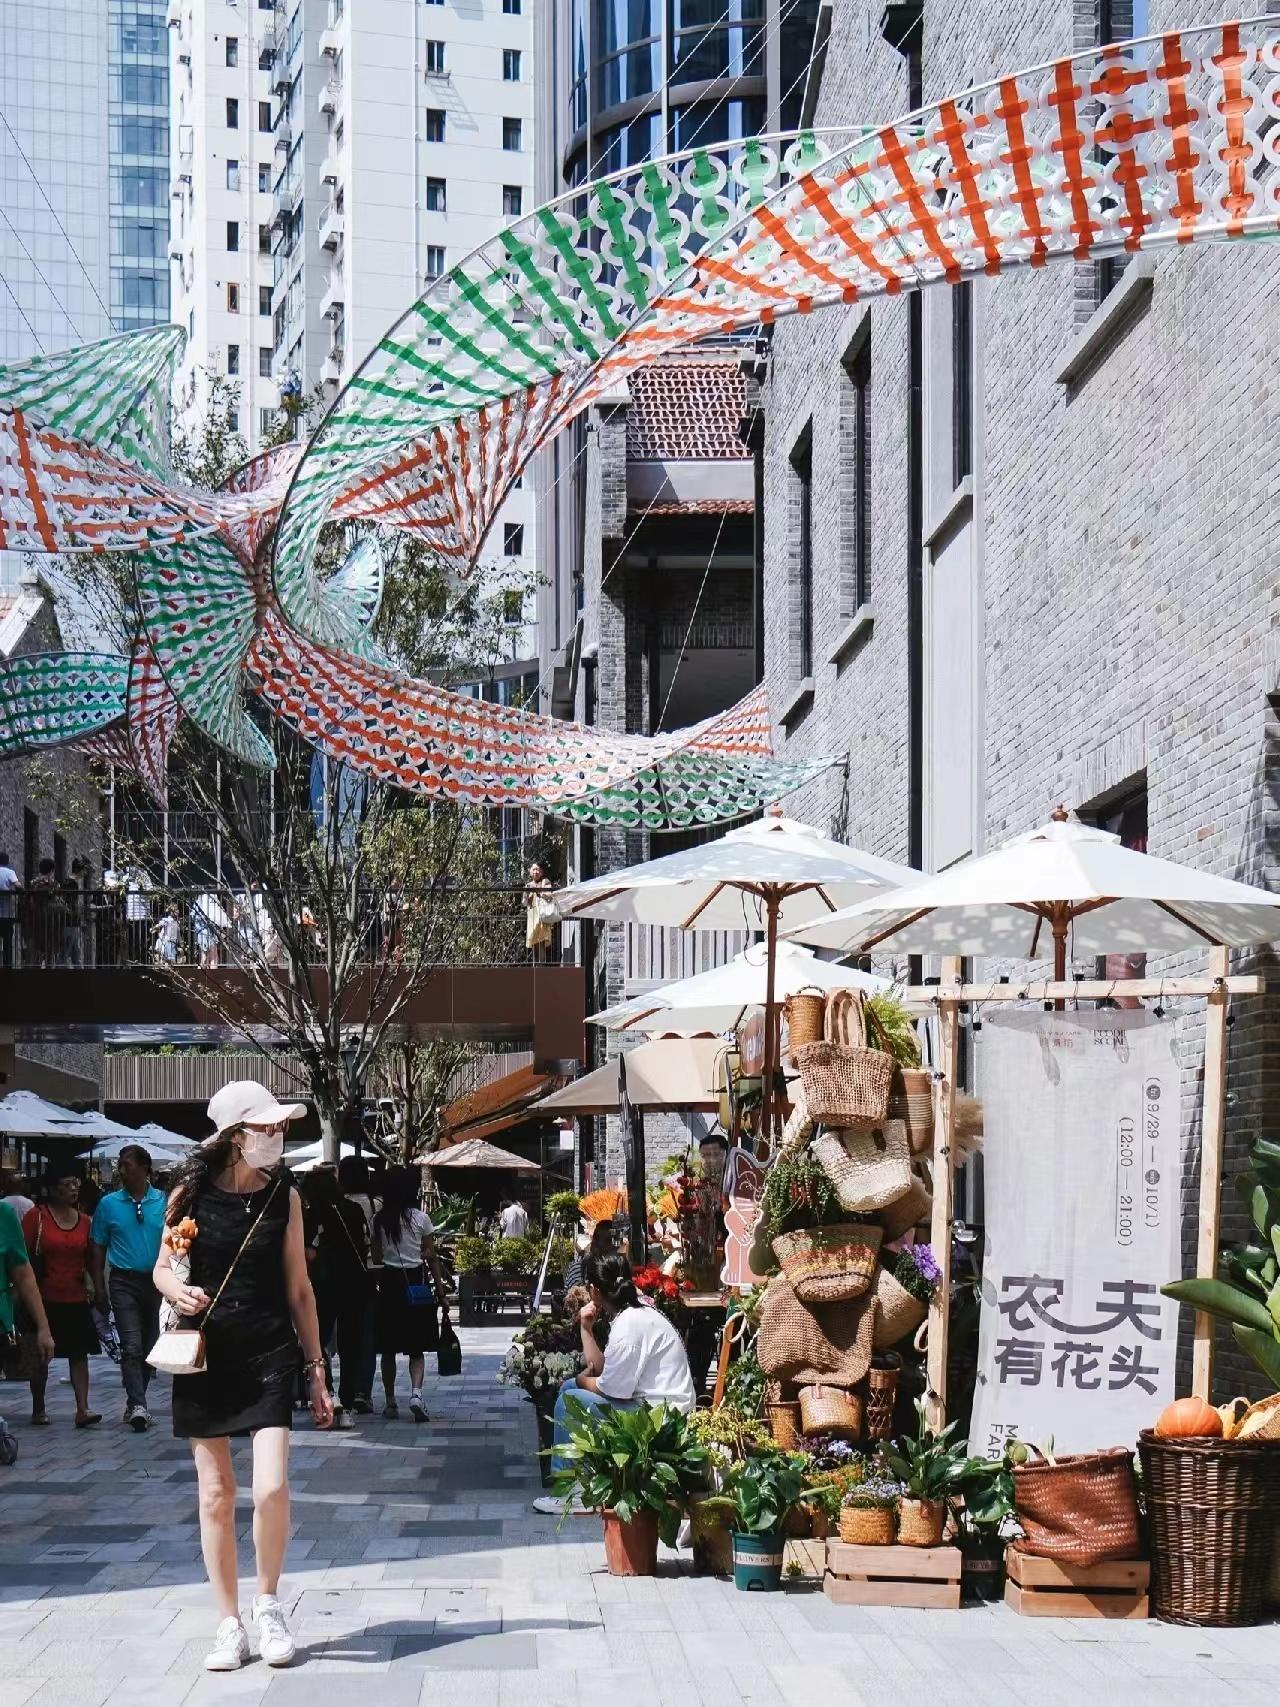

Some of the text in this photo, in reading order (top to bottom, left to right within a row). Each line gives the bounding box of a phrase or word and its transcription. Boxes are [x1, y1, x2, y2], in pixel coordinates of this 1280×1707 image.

[997, 1274, 1162, 1341] 农夫
[994, 1337, 1161, 1396] 有花头
